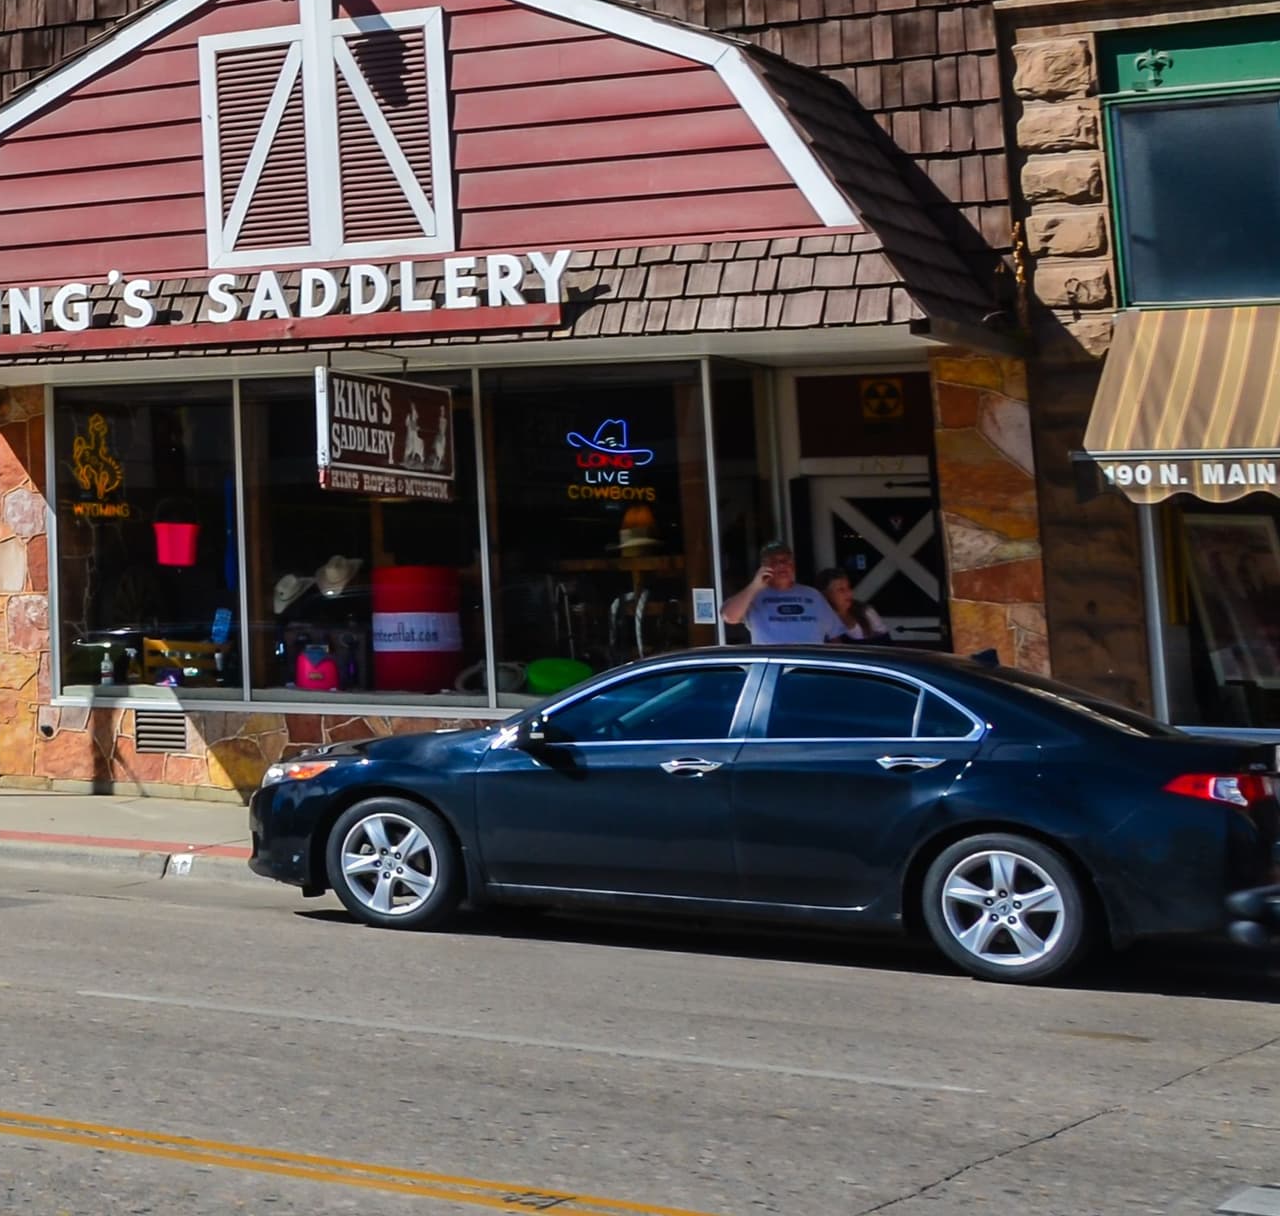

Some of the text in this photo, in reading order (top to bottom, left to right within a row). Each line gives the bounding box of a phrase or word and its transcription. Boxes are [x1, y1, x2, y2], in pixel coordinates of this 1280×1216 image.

[207, 249, 572, 323] SADDLERY
[332, 378, 393, 424] KING'S
[331, 422, 395, 464] SADDLERY
[576, 452, 634, 470] LONG
[331, 470, 359, 489] KING
[363, 474, 396, 493] ROPES
[405, 479, 449, 499] MUSEUM
[585, 471, 630, 485] LIVE
[1103, 463, 1277, 485] 190 N. MAIN
[567, 484, 656, 501] COWBOYS
[73, 503, 129, 517] WYOMING
